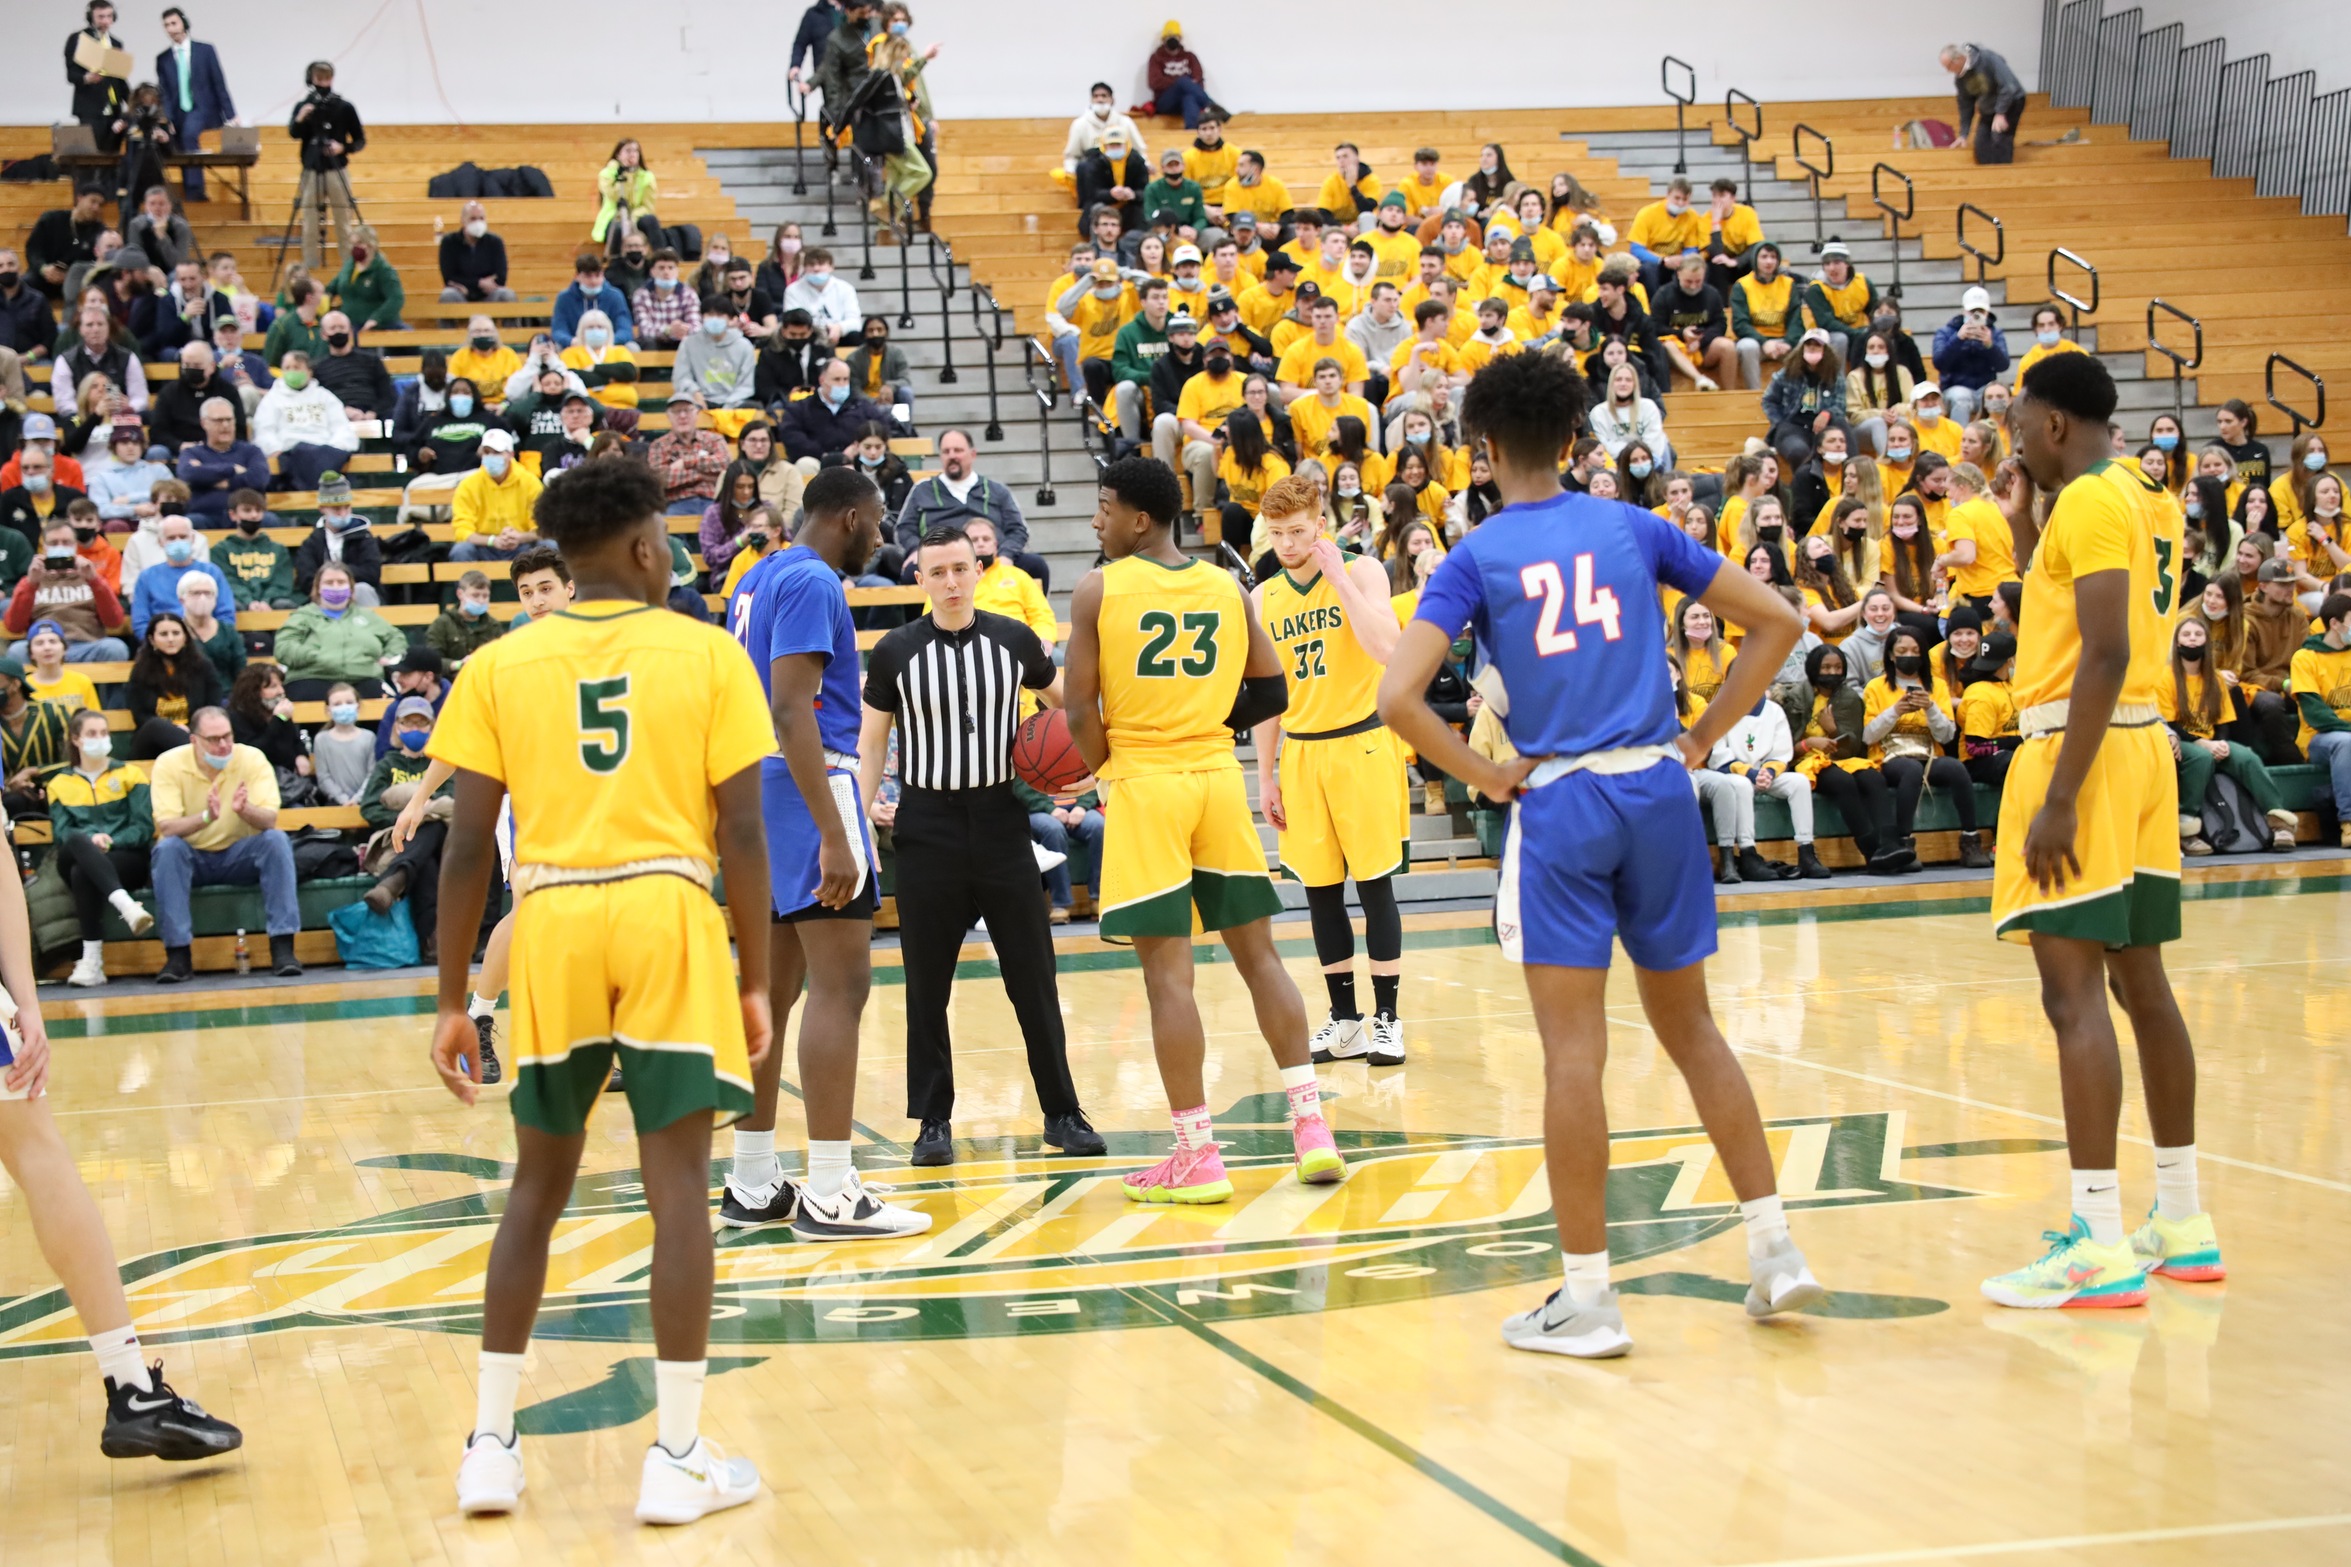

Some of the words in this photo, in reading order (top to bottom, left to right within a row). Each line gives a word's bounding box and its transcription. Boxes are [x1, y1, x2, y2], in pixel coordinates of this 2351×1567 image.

[1519, 552, 1623, 659] 24
[2150, 535, 2175, 618] 3
[1135, 608, 1222, 679] 23
[1269, 605, 1343, 643] LAKERS
[1292, 638, 1328, 681] 32
[576, 671, 632, 776] 5
